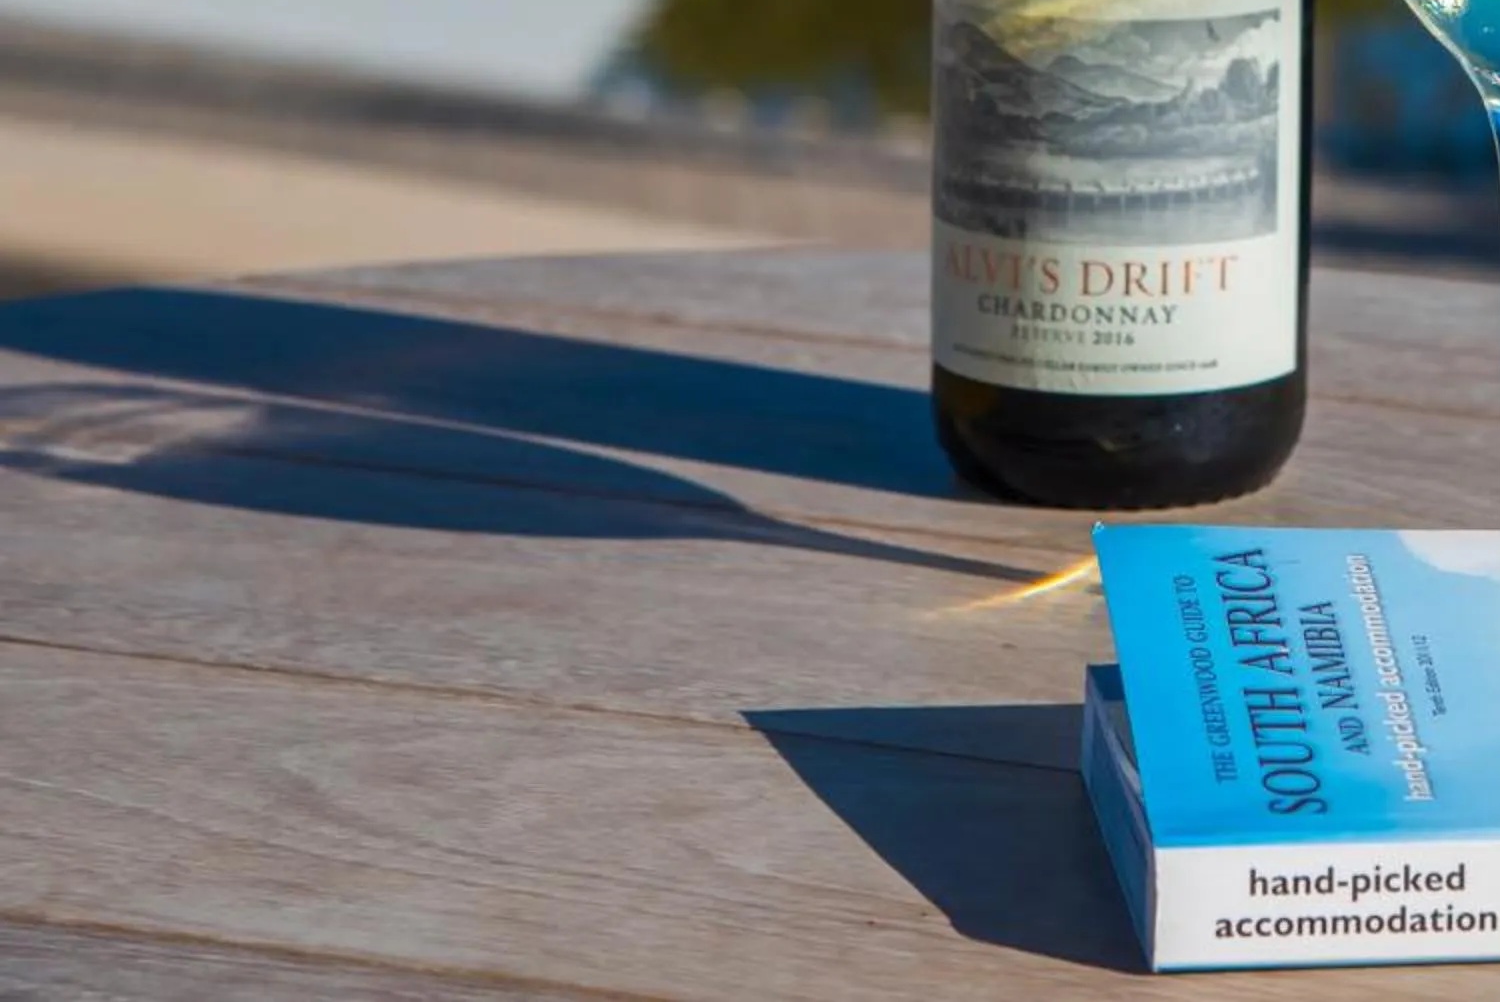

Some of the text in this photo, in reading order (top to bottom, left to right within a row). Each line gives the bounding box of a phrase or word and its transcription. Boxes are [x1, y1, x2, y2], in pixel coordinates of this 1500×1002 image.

[1080, 254, 1239, 297] DRIFT
[977, 294, 1179, 325] CHARDONNAY
[1092, 328, 1136, 347] 2016
[1173, 574, 1239, 785] THE GREENWOOD GUIDE TO
[1211, 548, 1328, 815] SOUTH AFRICA
[1297, 600, 1371, 756] AND NAMIBIA
[1346, 554, 1436, 802] hand-picked accommodation
[1248, 862, 1466, 901] hand-picked
[1214, 905, 1499, 938] accommodation
